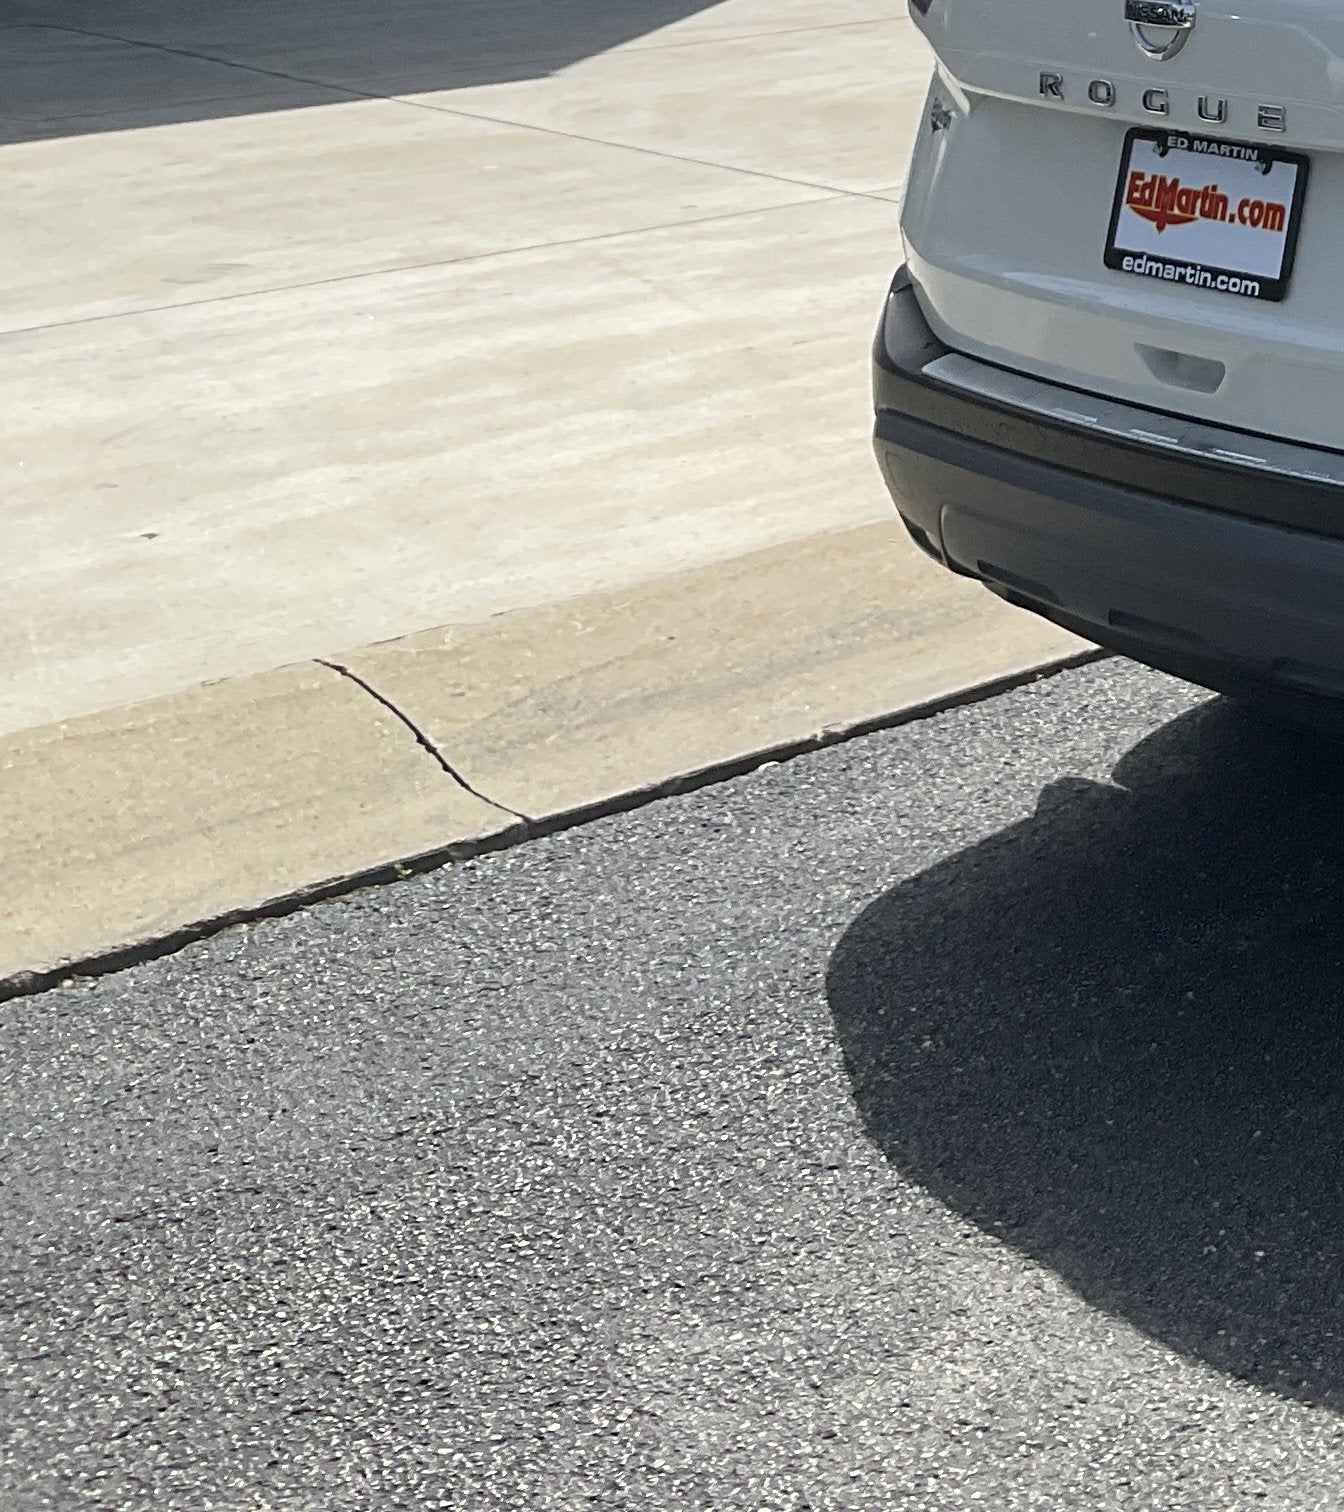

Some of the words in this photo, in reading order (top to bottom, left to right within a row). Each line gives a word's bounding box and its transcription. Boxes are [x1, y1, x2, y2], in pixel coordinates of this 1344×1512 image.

[1038, 70, 1287, 133] ROGUE
[1167, 136, 1189, 149] ED
[1193, 140, 1259, 161] MARTIN
[1126, 171, 1286, 233] EdMartin.com
[1122, 255, 1260, 296] edmartin.com
